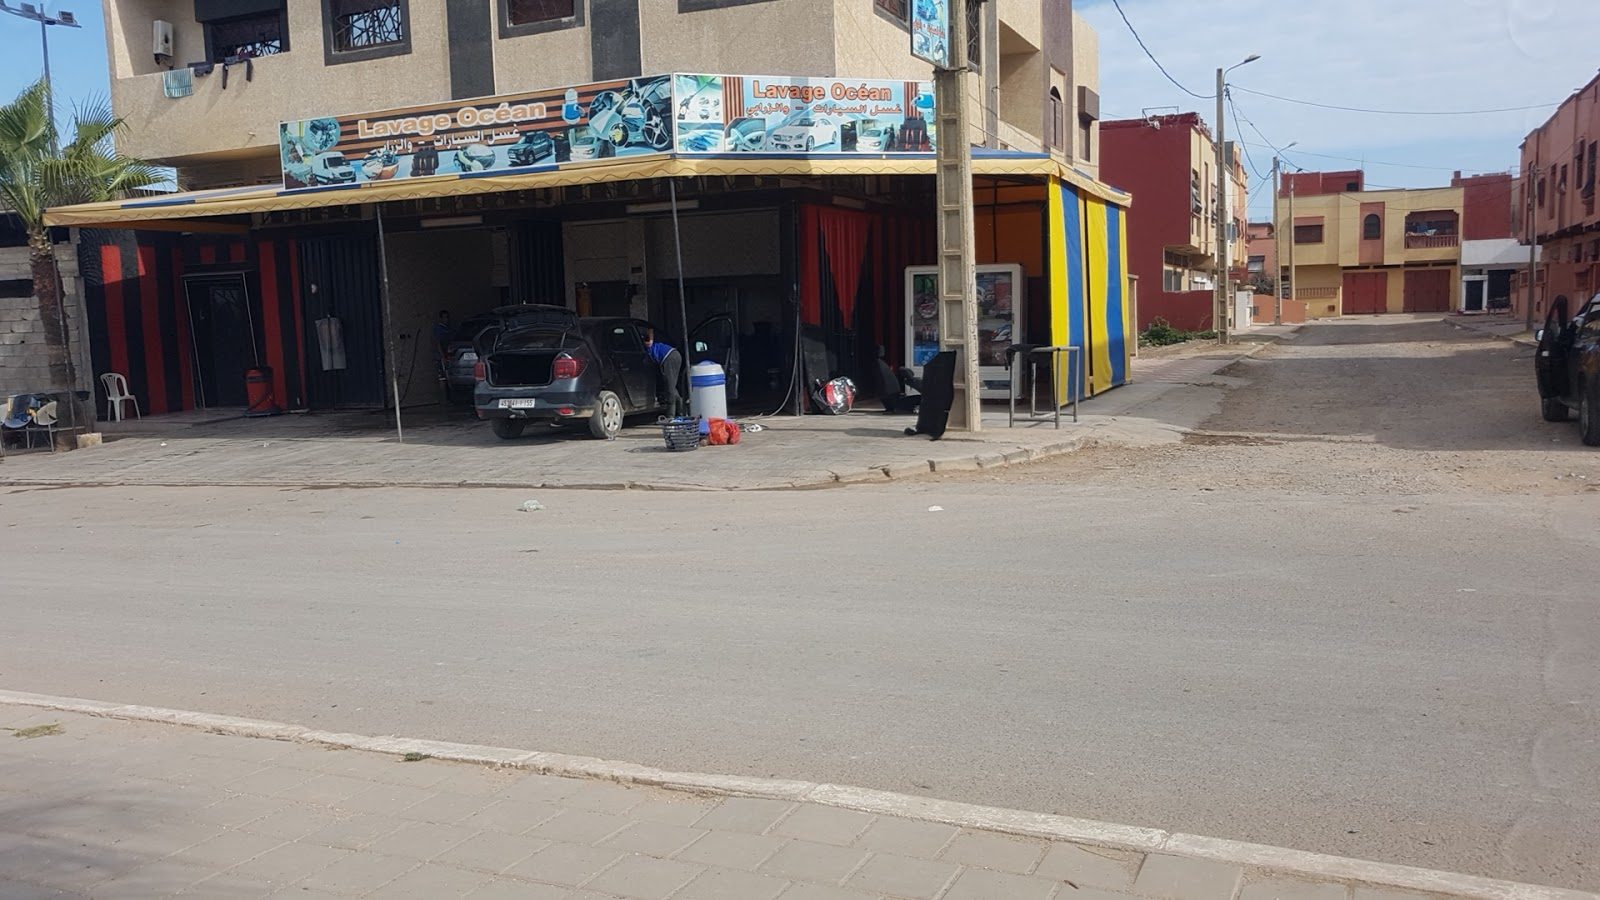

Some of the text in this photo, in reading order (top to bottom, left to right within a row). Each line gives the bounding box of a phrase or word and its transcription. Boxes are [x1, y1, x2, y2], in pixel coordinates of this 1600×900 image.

[753, 80, 892, 103] Lavage Océan
[812, 103, 867, 115] السيارات
[870, 103, 903, 115] غسل
[358, 102, 546, 138] Lavage Océan
[433, 130, 484, 149] السيارات
[487, 124, 521, 145] غسل
